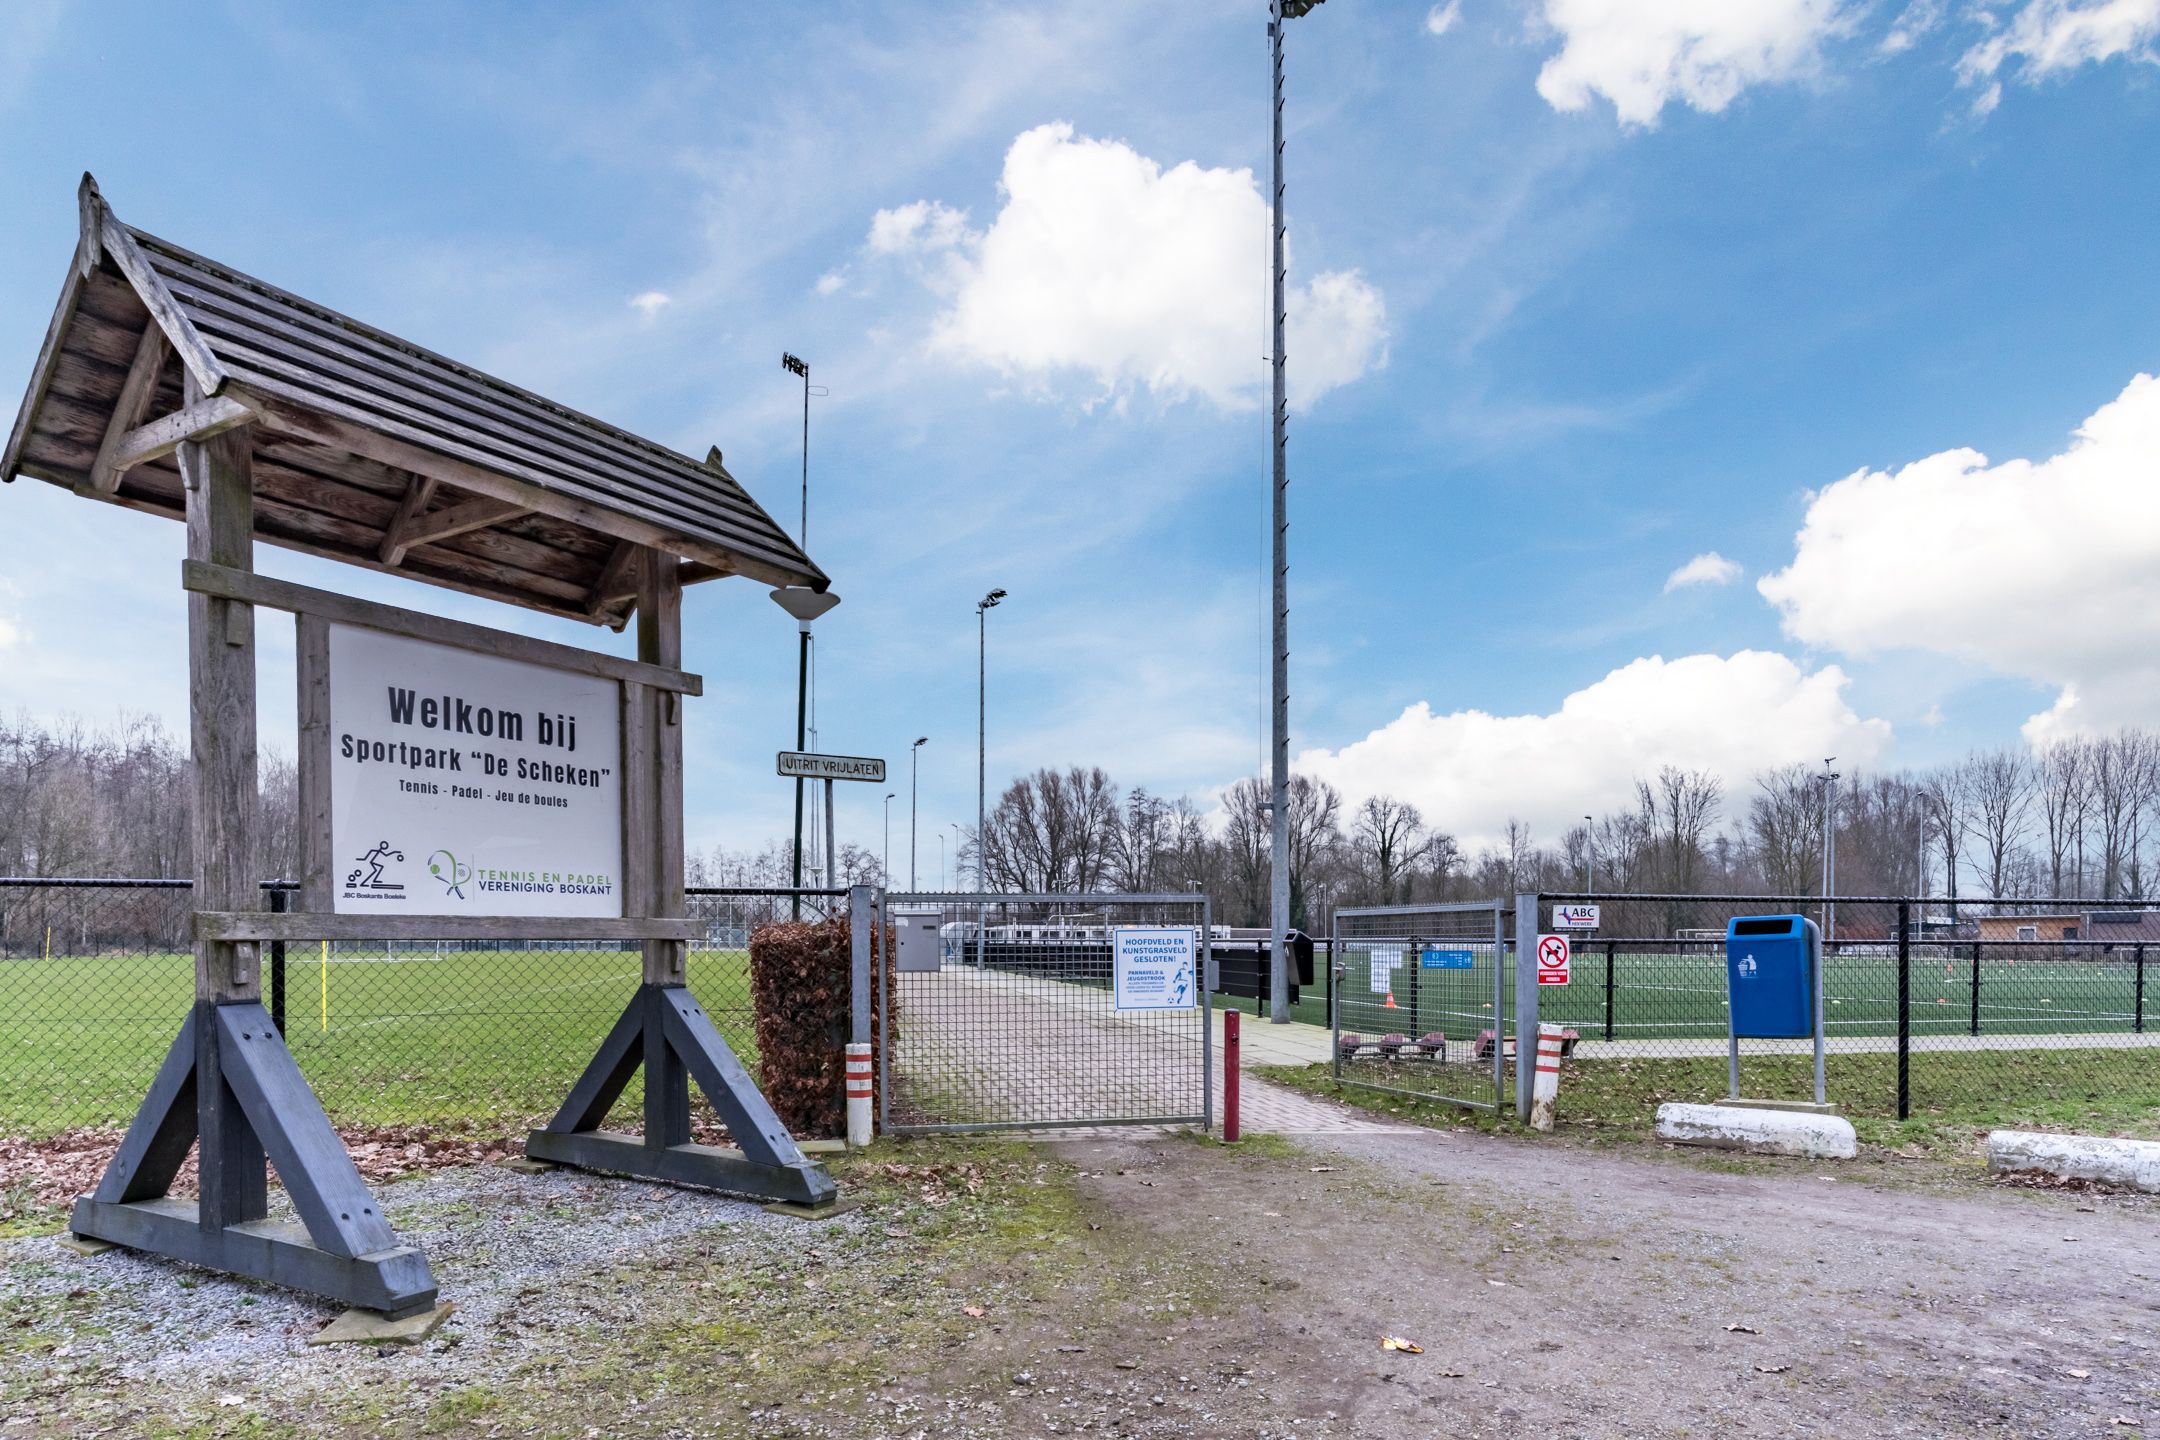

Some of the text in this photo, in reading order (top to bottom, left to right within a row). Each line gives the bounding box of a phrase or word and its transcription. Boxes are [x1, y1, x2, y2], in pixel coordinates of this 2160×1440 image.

[387, 686, 576, 752] Welkom bij
[341, 734, 462, 771] Sportpark
[786, 758, 879, 775] UITRIT VRIJLATEN
[399, 779, 438, 795] Tennis
[452, 786, 483, 799] Padel
[495, 789, 514, 803] Jeu
[518, 792, 531, 804] de
[534, 794, 568, 808] boules
[478, 869, 612, 885] TENNIS EN PADEL
[478, 880, 612, 895] VERENIGING BOSKANT
[1572, 908, 1595, 918] ABC
